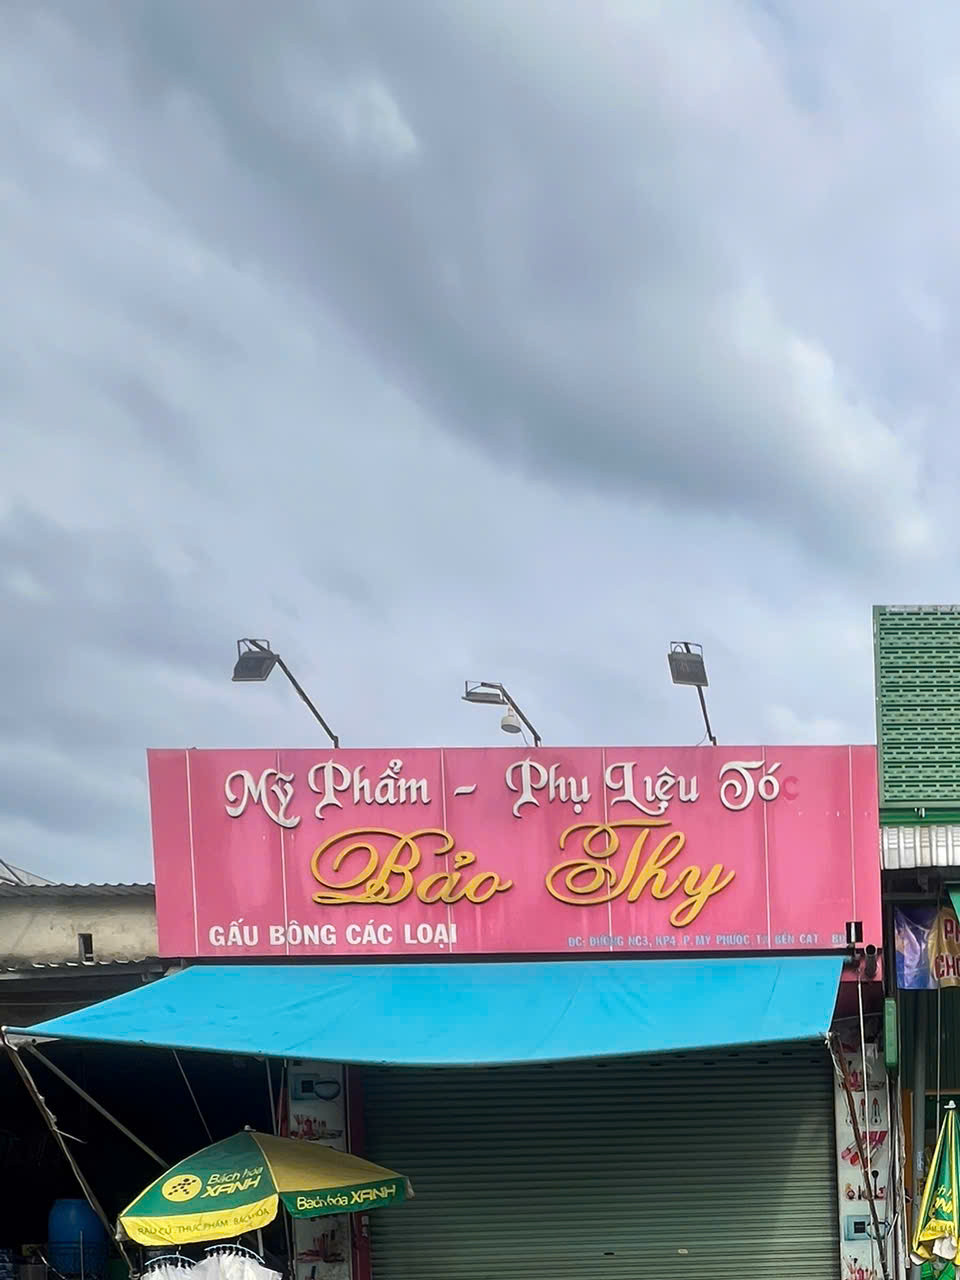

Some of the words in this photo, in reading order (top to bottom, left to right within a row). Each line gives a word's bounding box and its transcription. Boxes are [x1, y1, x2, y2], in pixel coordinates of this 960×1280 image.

[225, 768, 301, 828] Mỹ
[307, 759, 431, 820] Phẩm
[505, 757, 591, 818] Phụ
[605, 765, 699, 816] Liệu
[310, 827, 513, 905] Bảo
[545, 818, 736, 928] Thy
[208, 918, 259, 946] GẤU
[269, 920, 336, 946] BÔNG
[346, 920, 393, 945] CÁC
[404, 923, 457, 948] LOẠI
[200, 1175, 262, 1198] XANH
[350, 1184, 397, 1205] XANH
